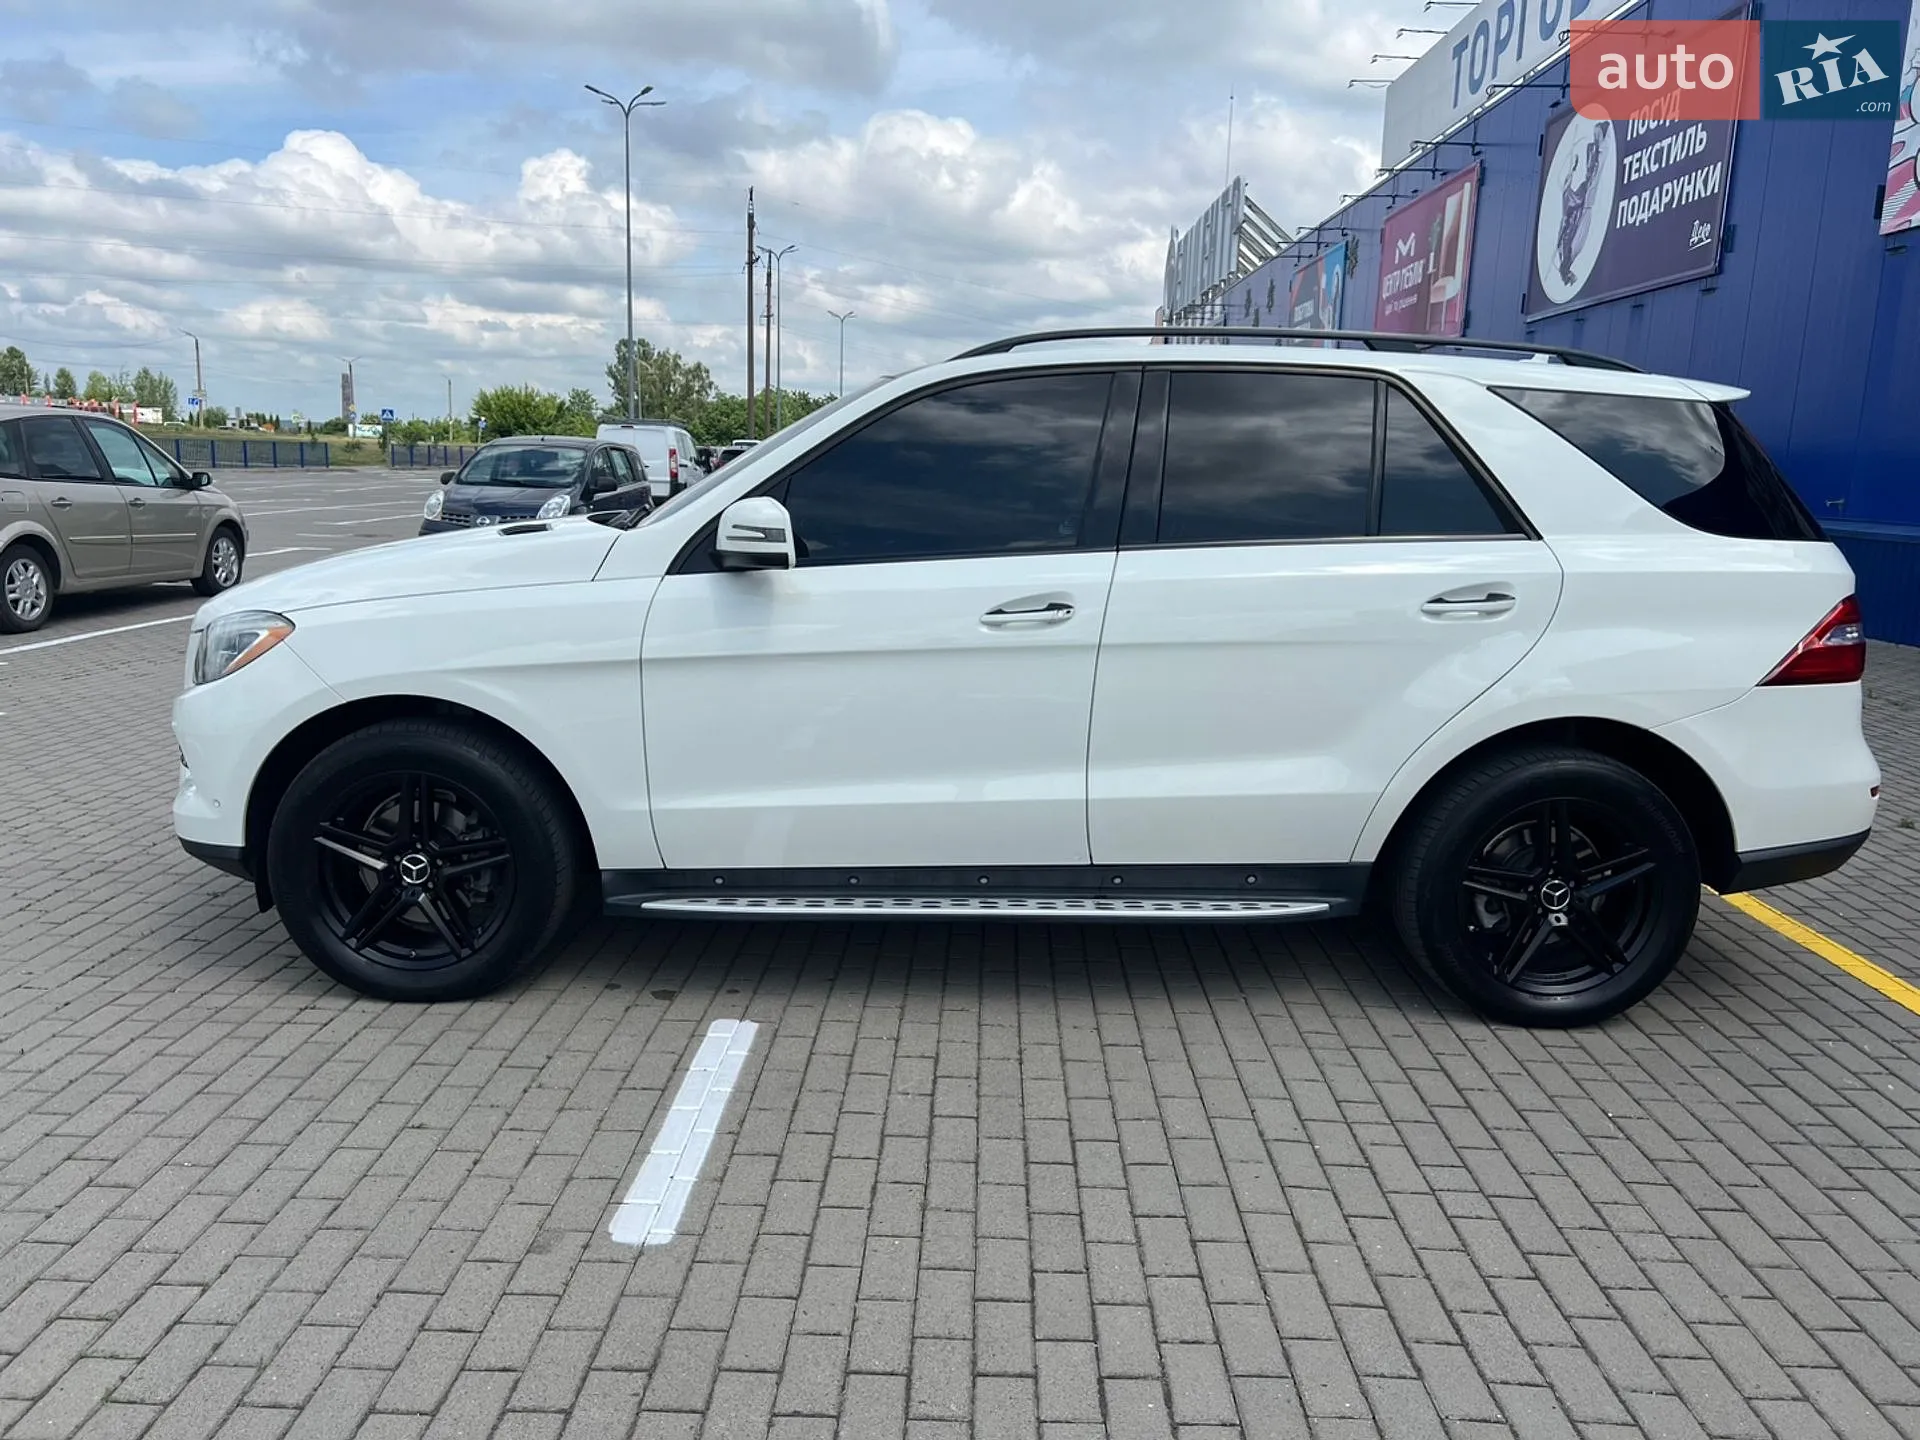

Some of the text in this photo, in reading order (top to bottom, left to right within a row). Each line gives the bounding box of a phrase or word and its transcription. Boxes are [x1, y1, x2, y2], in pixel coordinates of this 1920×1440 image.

[1627, 88, 1681, 141] ПОСУД
[1622, 122, 1708, 185] ТЕКСТИЛЬ
[1616, 161, 1722, 229] ПОДАРУНКИ
